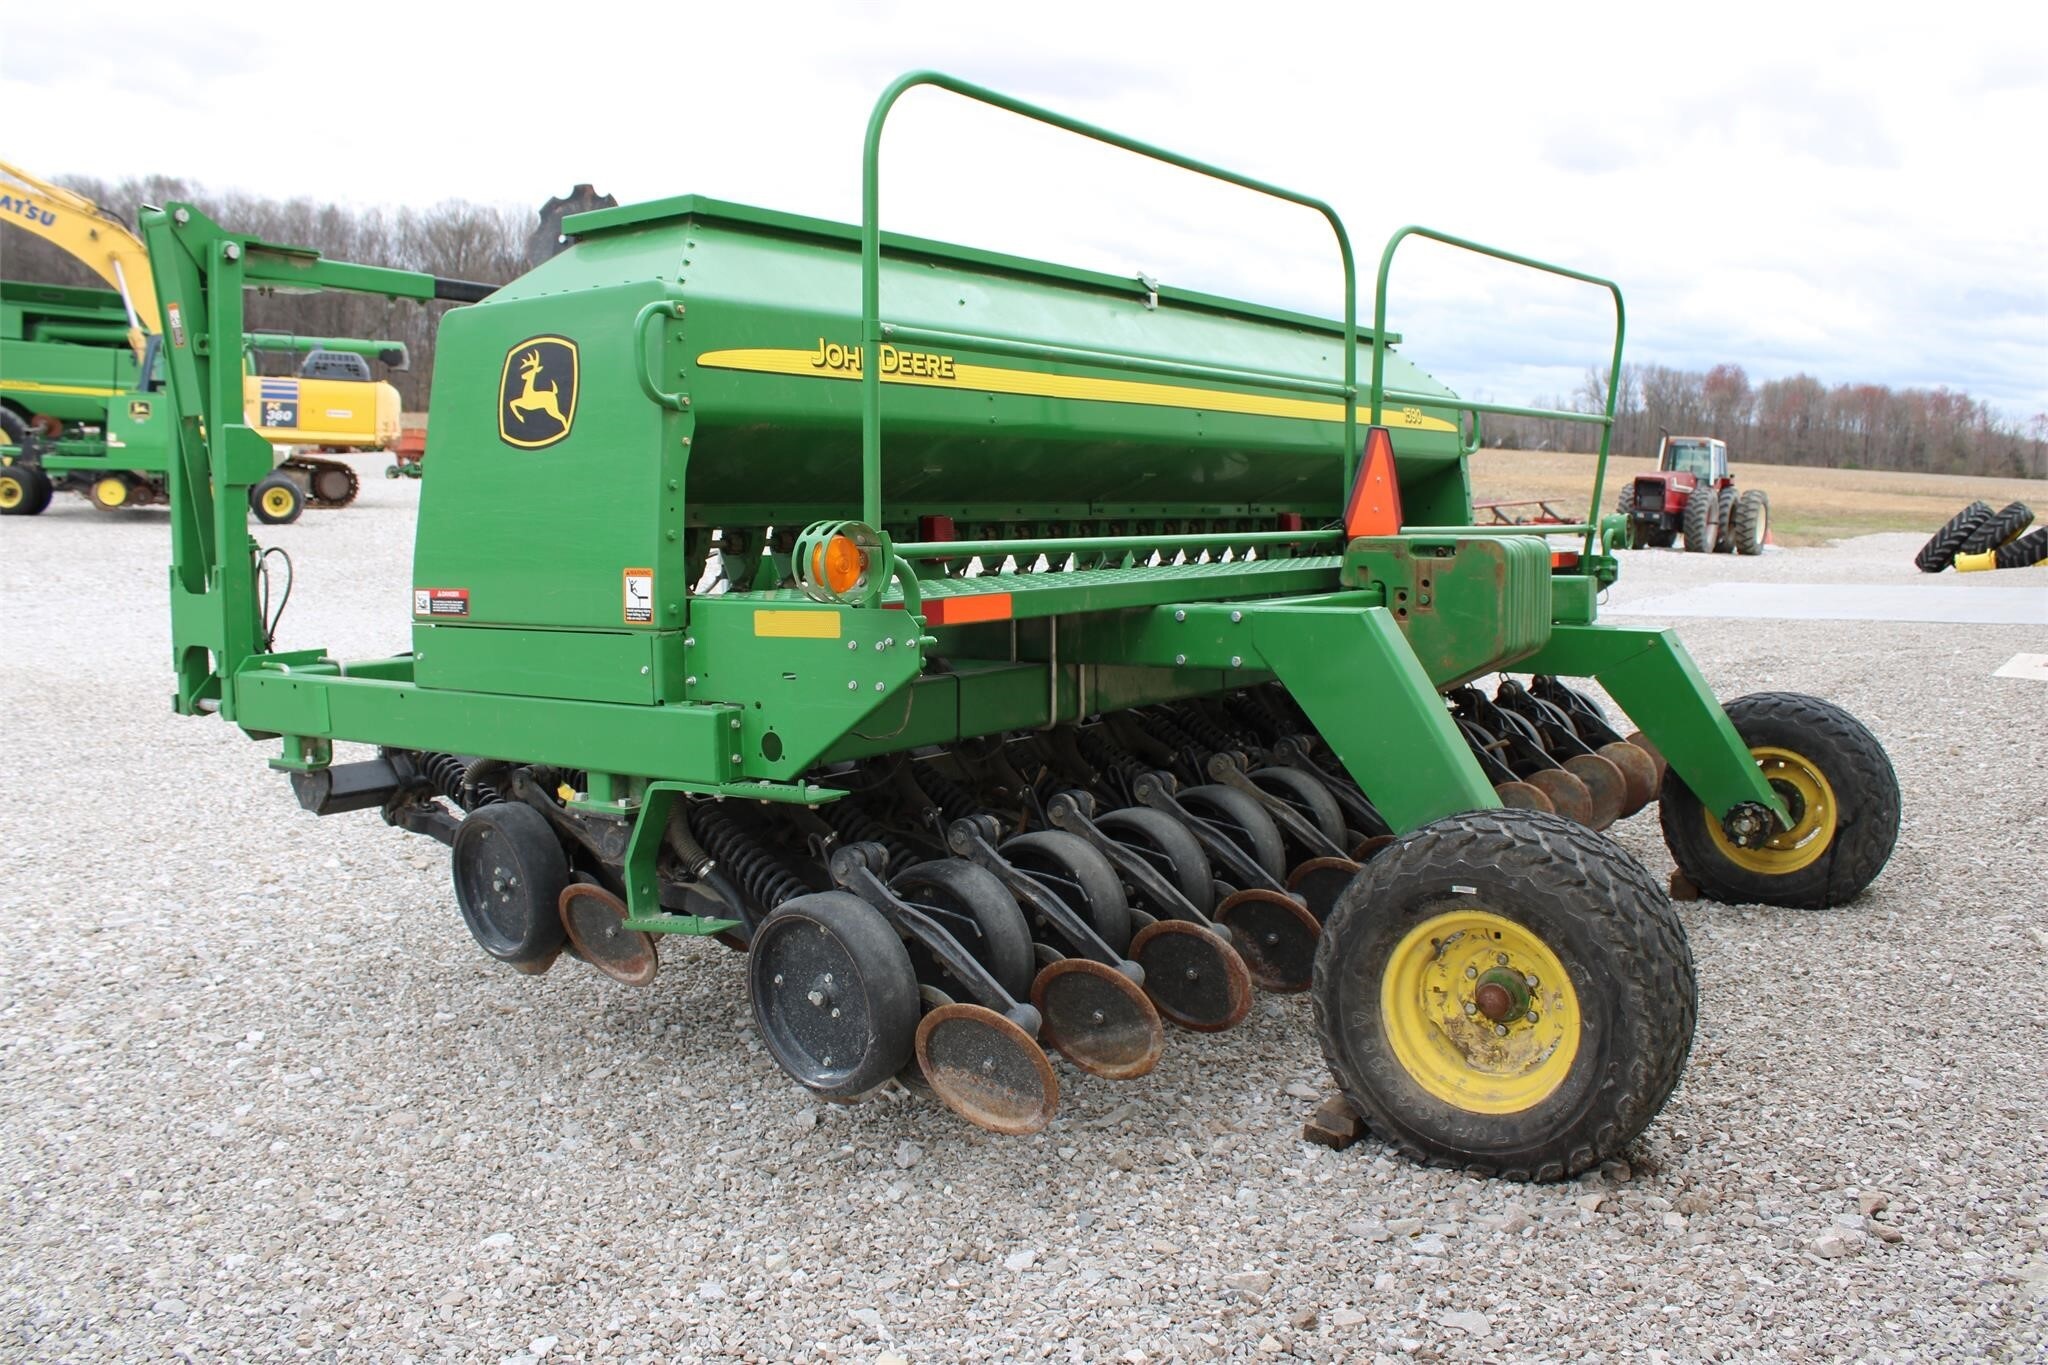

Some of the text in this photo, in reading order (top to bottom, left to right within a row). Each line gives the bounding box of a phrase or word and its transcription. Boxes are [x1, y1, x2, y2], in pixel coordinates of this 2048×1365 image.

[812, 337, 955, 379] JOH DEERE
[266, 410, 292, 421] 360
